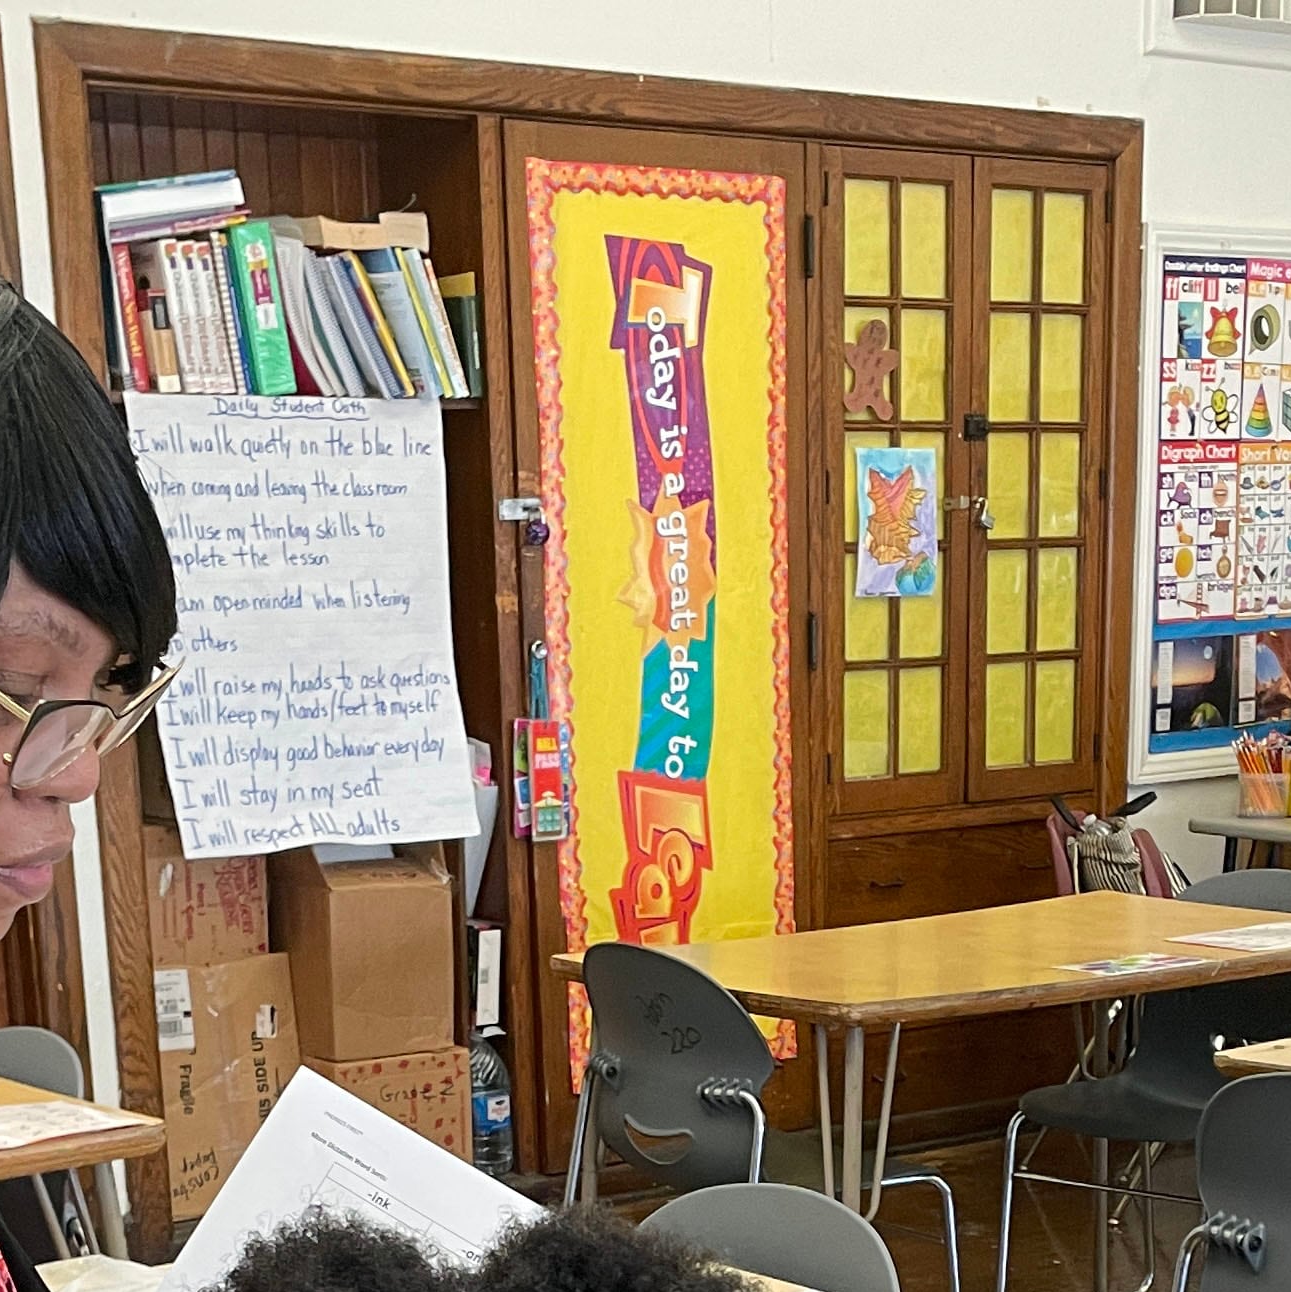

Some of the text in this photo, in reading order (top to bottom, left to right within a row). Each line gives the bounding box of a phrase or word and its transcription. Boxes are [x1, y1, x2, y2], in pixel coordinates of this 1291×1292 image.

[1249, 262, 1284, 280] Magic
[216, 398, 258, 416] Daily
[272, 397, 325, 415] Student
[134, 423, 433, 461] I will walk quietly on the blue line
[1162, 445, 1236, 462] Digraph Chart
[1241, 447, 1270, 461] Short
[235, 473, 259, 498] and
[266, 469, 307, 504] leaving
[312, 470, 340, 497] the
[196, 511, 386, 548] use my thinking skills to
[627, 264, 704, 780] Today is a great day to
[234, 543, 329, 568] the lesson
[178, 578, 411, 615] am when listening
[192, 625, 239, 652] others
[180, 666, 206, 697] will
[214, 674, 258, 695] raise
[262, 680, 284, 702] my
[290, 661, 333, 695] hands
[335, 660, 355, 689] to
[360, 664, 385, 689] ask
[390, 663, 451, 694] questions
[160, 688, 442, 730] I will keep my myself
[169, 736, 188, 769] I
[191, 736, 219, 766] will
[223, 736, 280, 772] display
[285, 735, 319, 772] good
[324, 733, 377, 758] behavior
[175, 766, 385, 813] I will stay in my seat
[183, 807, 402, 853] I will respect ALL adults
[254, 1056, 270, 1092] SIDE
